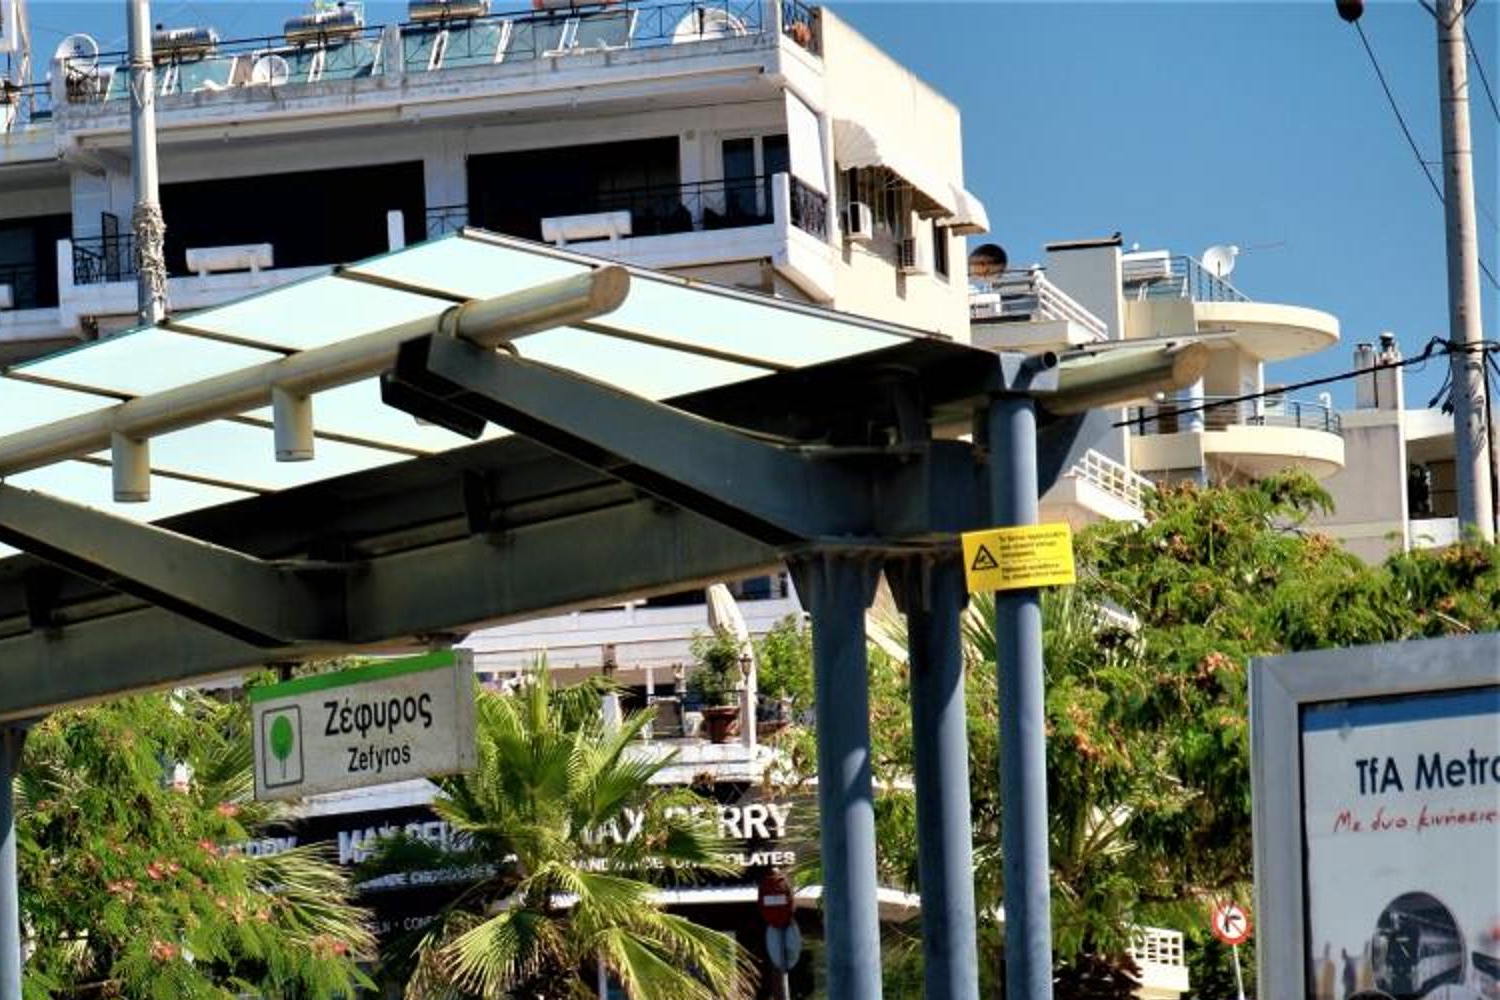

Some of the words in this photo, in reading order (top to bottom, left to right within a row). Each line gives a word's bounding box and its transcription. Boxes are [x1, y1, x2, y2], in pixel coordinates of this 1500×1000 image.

[324, 692, 433, 738] Ζέφυρος
[348, 744, 412, 773] Zefyros
[1356, 757, 1404, 795] TfA
